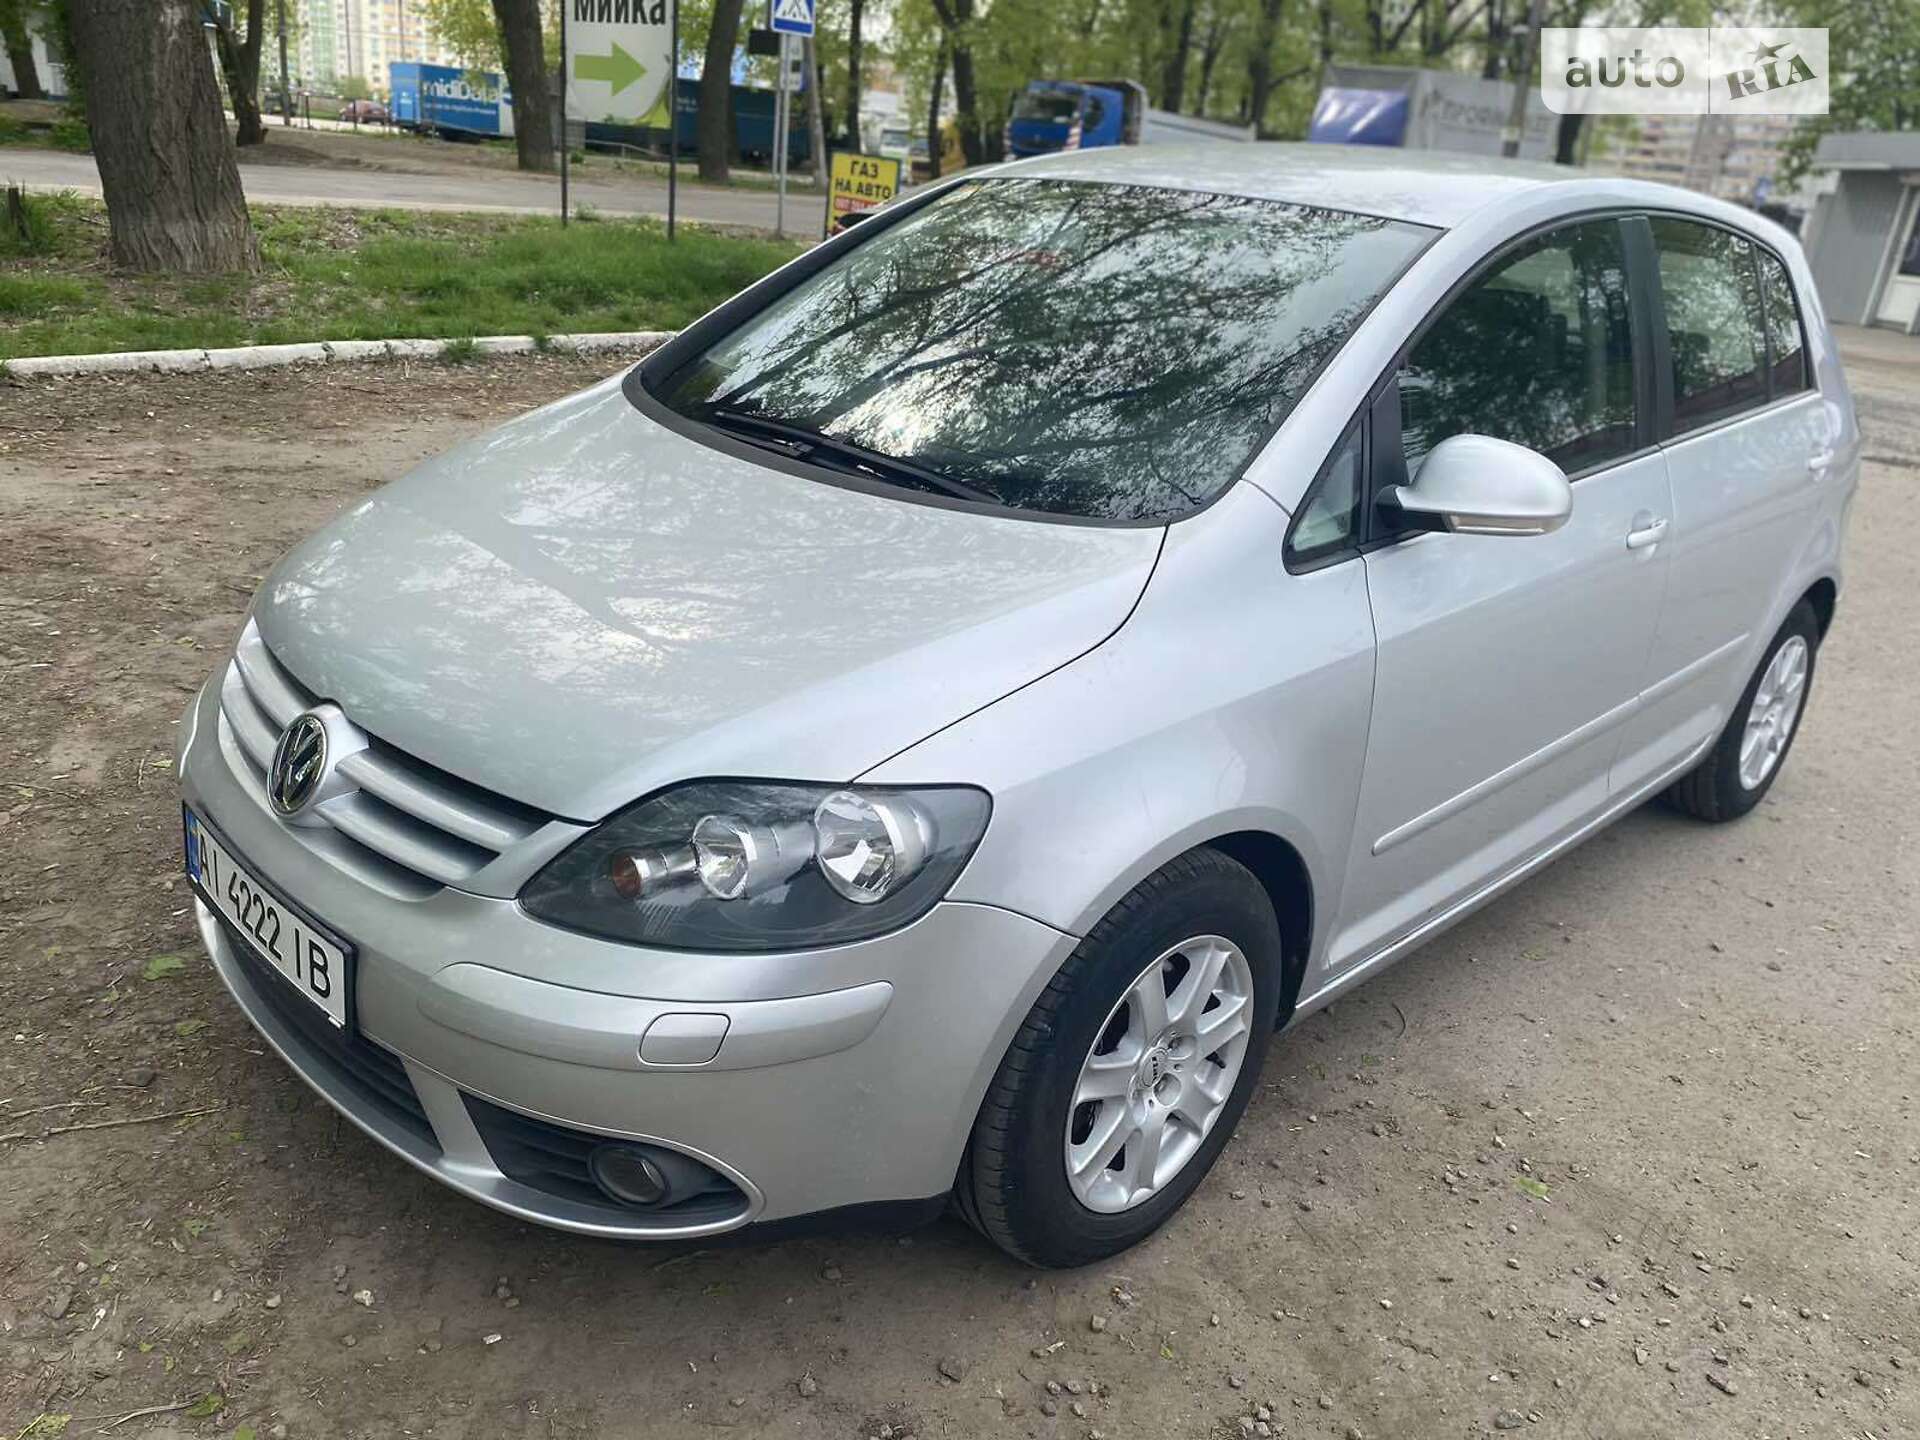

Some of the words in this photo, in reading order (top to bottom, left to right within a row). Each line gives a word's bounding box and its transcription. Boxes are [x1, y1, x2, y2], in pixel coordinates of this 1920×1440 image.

[850, 160, 879, 178] ГАЗ
[835, 177, 851, 192] НА
[857, 182, 892, 199] АВТО
[200, 834, 219, 897] AI
[228, 871, 282, 961] 4222
[294, 927, 331, 998] IB
